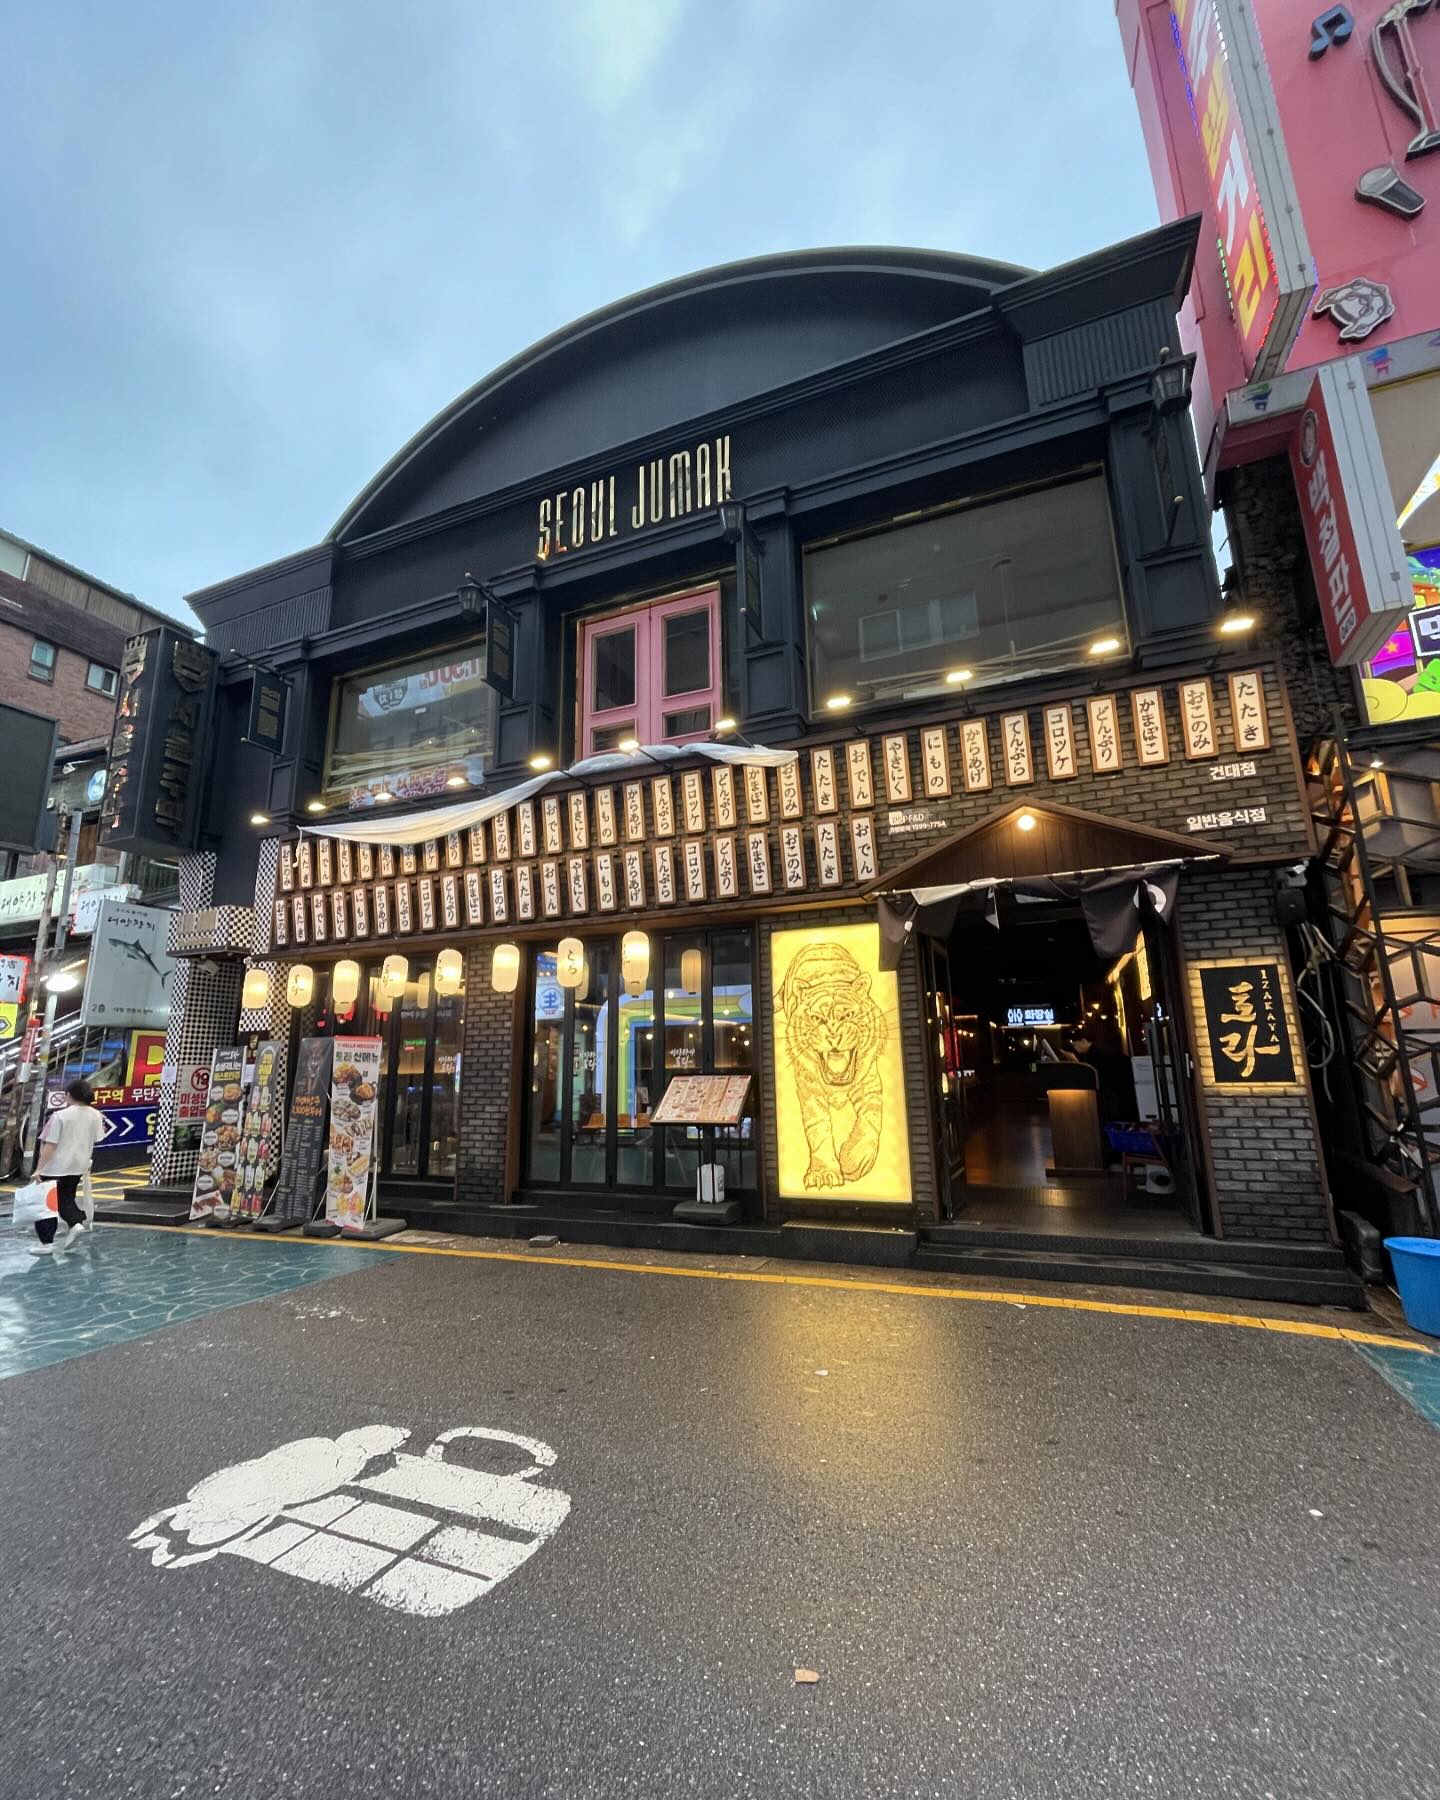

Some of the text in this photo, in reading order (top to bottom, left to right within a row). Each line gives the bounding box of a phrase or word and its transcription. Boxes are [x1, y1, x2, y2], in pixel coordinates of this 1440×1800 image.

[536, 435, 732, 561] SEOUL JUMAK
[1095, 704, 1114, 763] どんぶり
[1139, 697, 1160, 756] かまぼこ
[1187, 689, 1211, 750] おこのみ
[1237, 680, 1259, 742] たたき
[816, 755, 831, 806] たたき
[851, 749, 868, 801] おでん
[888, 741, 905, 796] やきにく
[927, 734, 944, 788] にもの
[1209, 761, 1257, 780] 건대점
[718, 772, 731, 821] どんぶり
[781, 763, 798, 812] おこのみ
[521, 807, 532, 850] たたき
[546, 804, 558, 847] おでん
[599, 794, 612, 839] にもの
[1186, 807, 1267, 831] 일반음식점
[719, 841, 733, 890] どんぶり
[751, 839, 767, 887] かまぼこ
[785, 831, 802, 883] おこのみ
[820, 828, 835, 880] たたき
[855, 823, 873, 875] おでん
[519, 869, 530, 913] たたき
[544, 868, 556, 910] おでん
[599, 858, 612, 904] にもの
[1025, 1008, 1054, 1020] 화장실
[1219, 981, 1280, 1078] 토라
[1260, 969, 1279, 1042] IZAKAYA
[195, 1072, 210, 1086] 19
